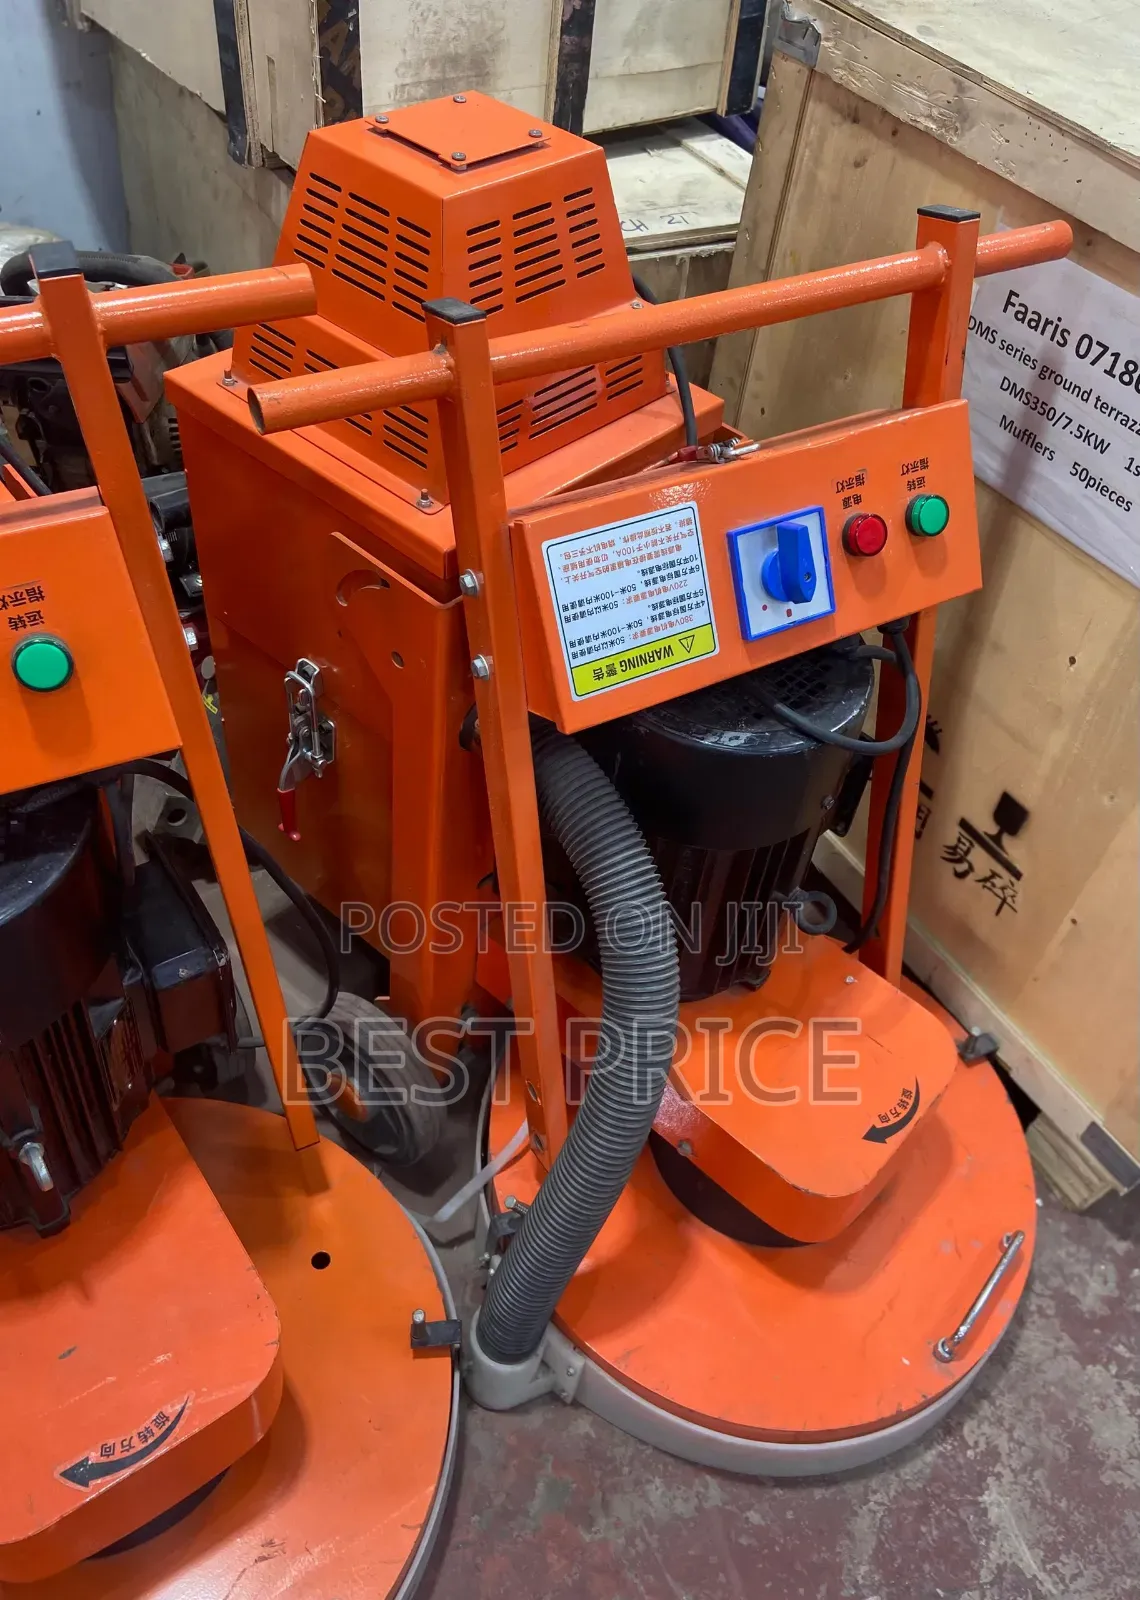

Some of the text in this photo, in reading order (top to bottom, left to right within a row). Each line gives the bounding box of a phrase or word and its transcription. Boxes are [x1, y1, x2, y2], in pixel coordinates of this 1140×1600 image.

[1003, 290, 1071, 348] Faaris
[968, 316, 998, 344] DMS
[999, 338, 1038, 371] series
[1038, 365, 1092, 404] ground
[1000, 376, 1111, 455] DMS350/7.5KW
[901, 457, 929, 476] 指示灯
[999, 415, 1133, 513] Mufflers 50pieces
[836, 473, 865, 494] 指示灯
[842, 494, 863, 509] 电源
[907, 476, 926, 491] 运转
[8, 610, 45, 631] 运转
[592, 644, 674, 681] WARNING 警告
[940, 831, 1018, 917] 易碎
[878, 1088, 913, 1124] 旋转方向
[100, 1412, 170, 1458] 旋转方向
